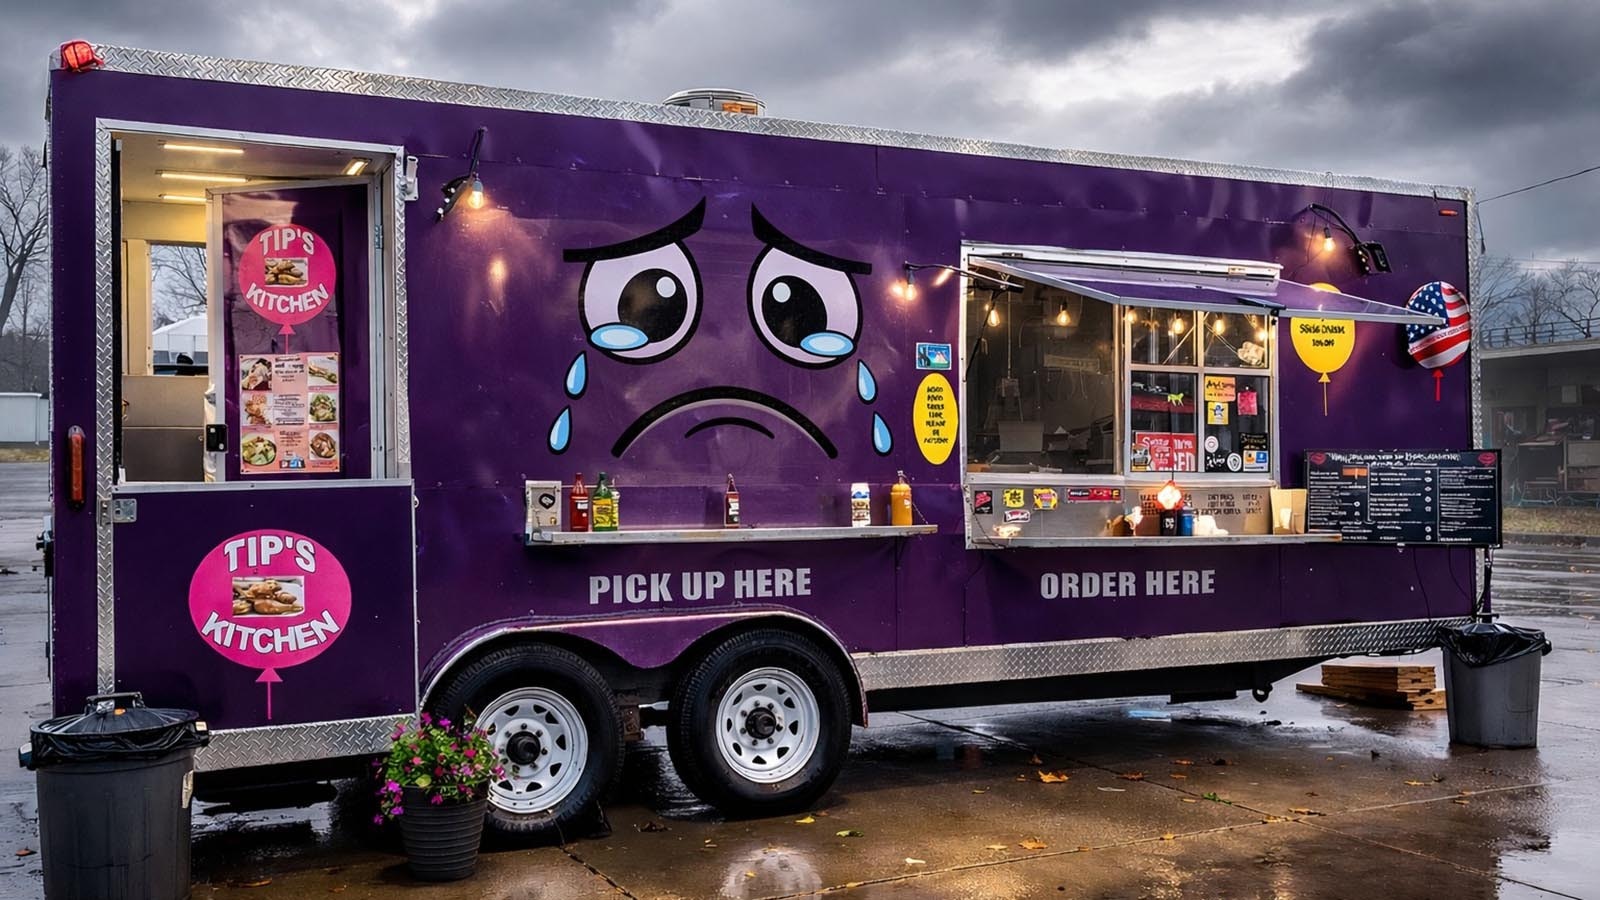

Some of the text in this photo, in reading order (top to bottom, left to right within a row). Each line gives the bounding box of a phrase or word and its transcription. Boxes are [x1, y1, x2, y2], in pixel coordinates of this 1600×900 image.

[259, 227, 315, 256] TIP'S
[245, 282, 329, 314] KITCHEN
[223, 534, 317, 574] TIP'S
[589, 567, 812, 605] PICK UP HERE
[1040, 569, 1216, 600] ORDER HERE
[200, 609, 341, 655] KITCHEN
